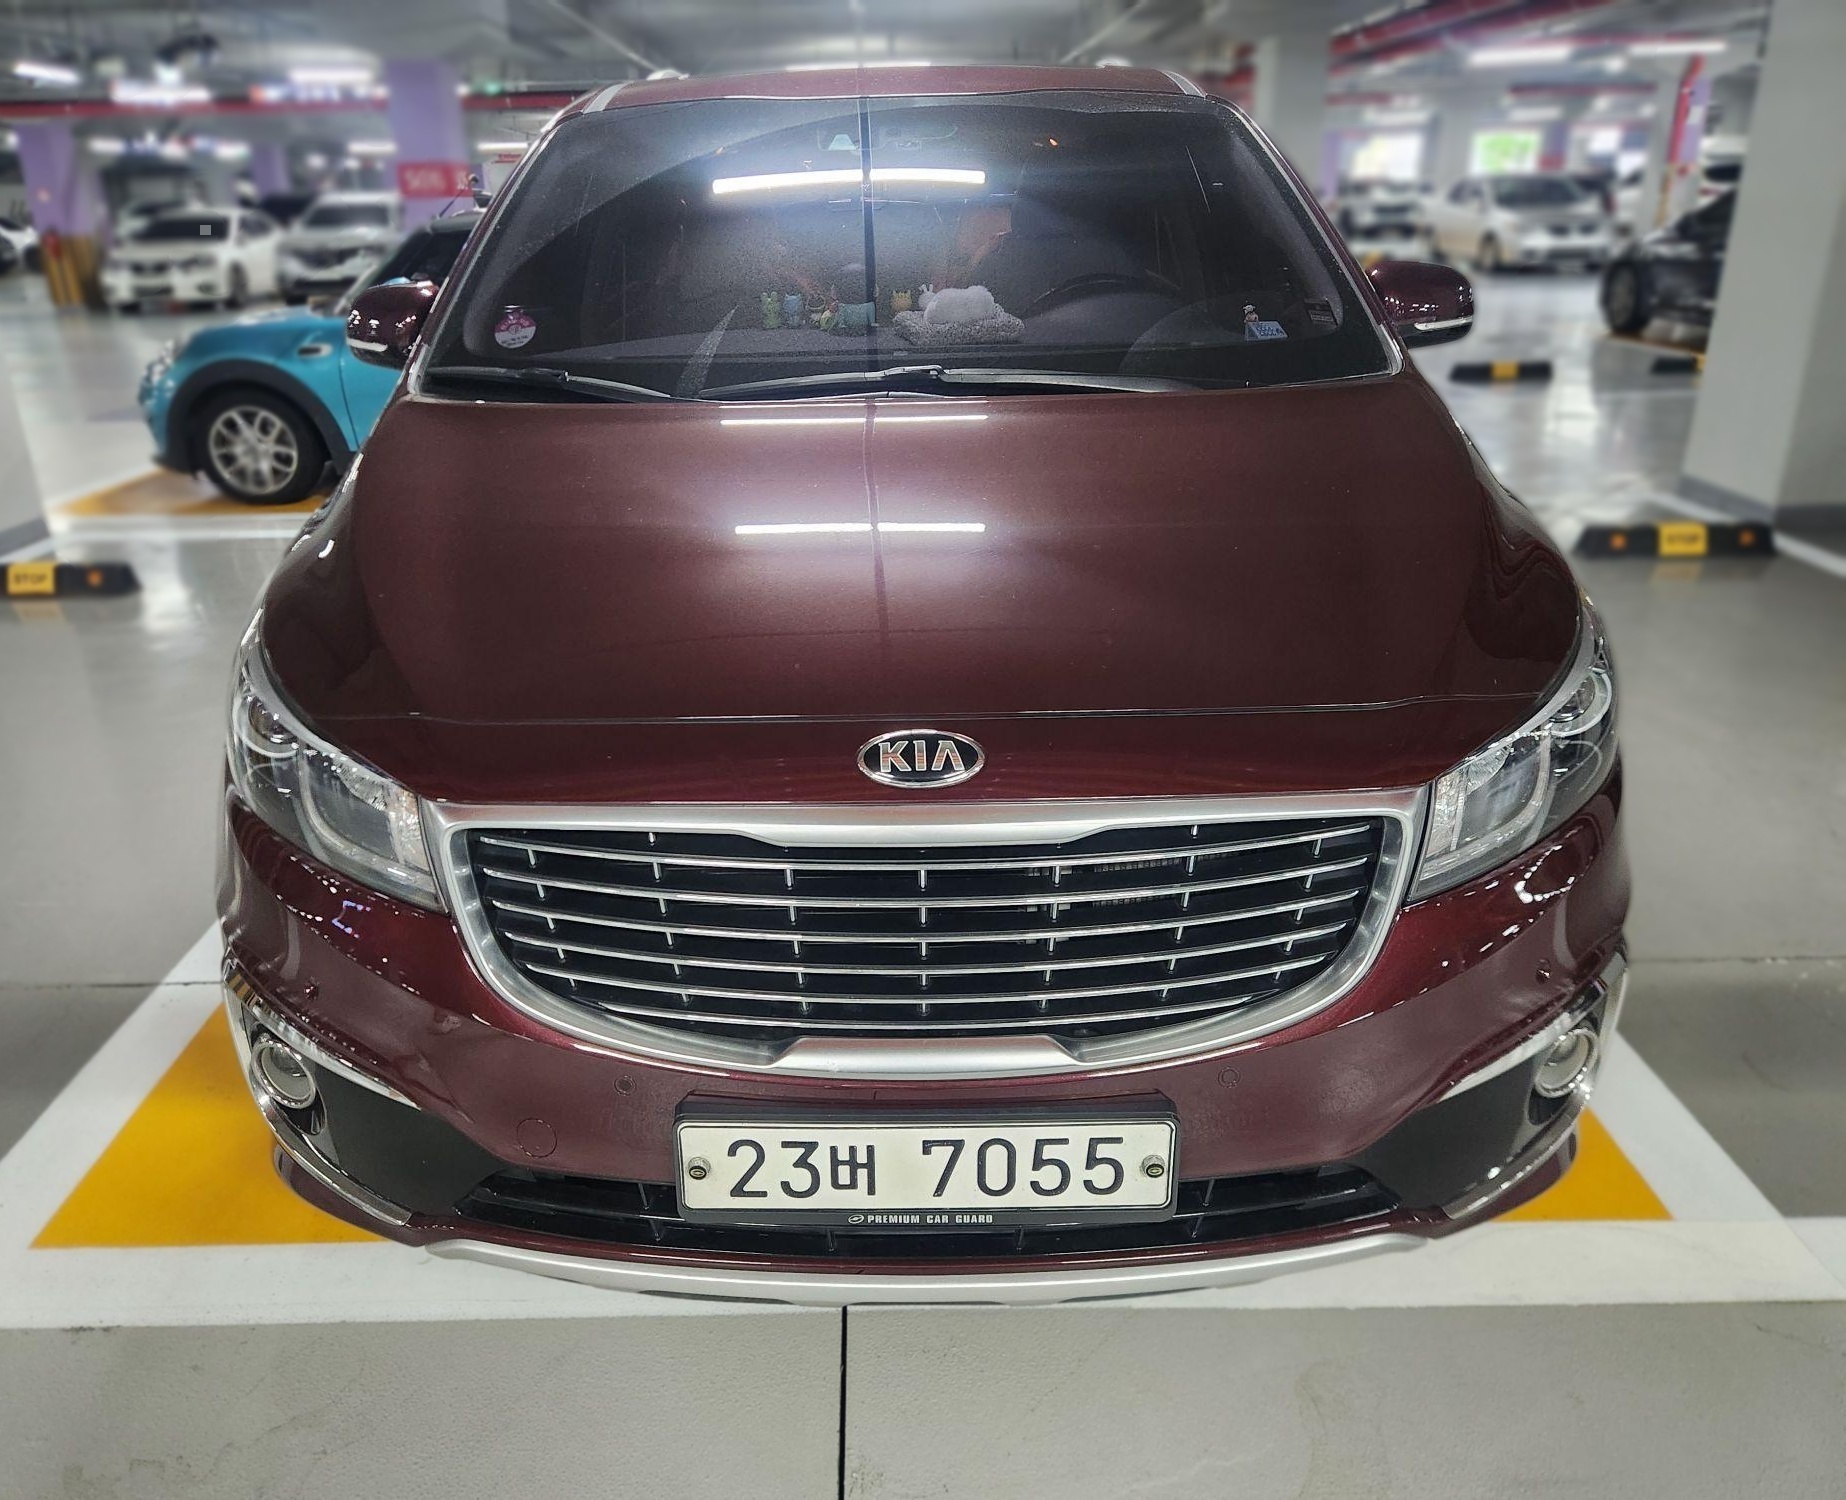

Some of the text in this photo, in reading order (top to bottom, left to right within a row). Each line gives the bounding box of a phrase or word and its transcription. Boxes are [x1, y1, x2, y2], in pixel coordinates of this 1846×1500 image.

[879, 740, 966, 773] KIA
[726, 1137, 1126, 1199] 23버 7055
[867, 1214, 994, 1224] PREMIUM CAR GUARD
